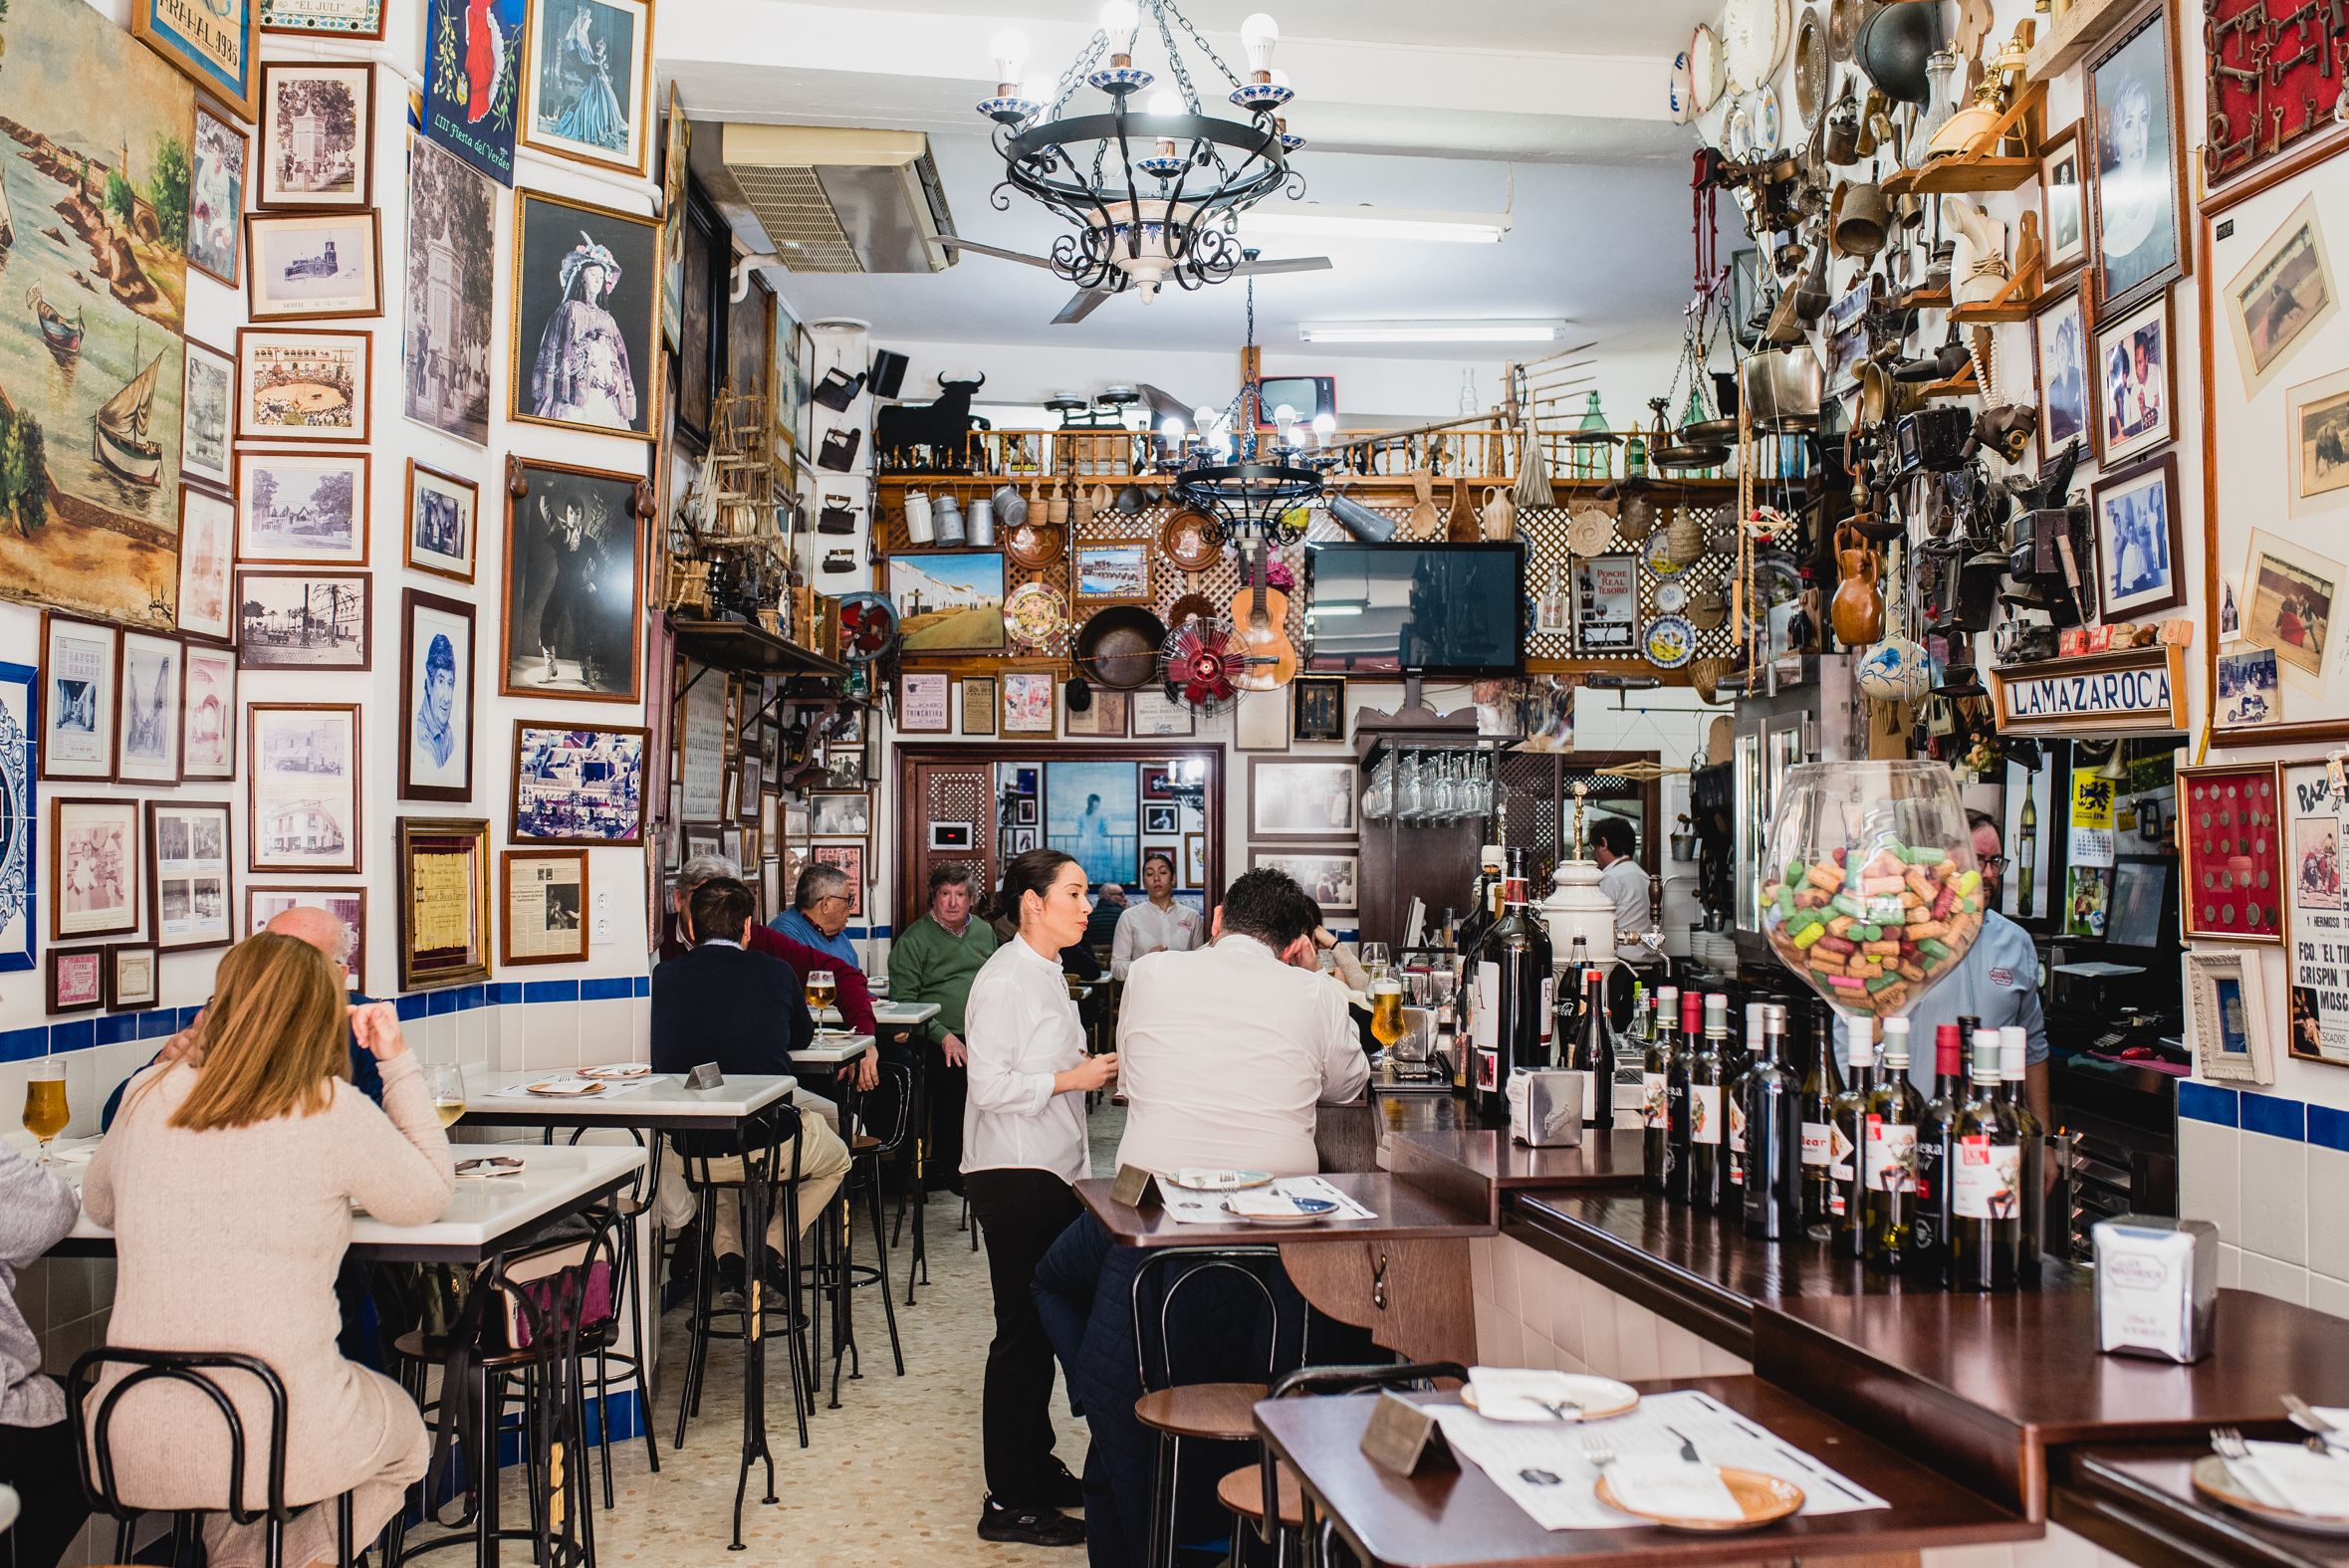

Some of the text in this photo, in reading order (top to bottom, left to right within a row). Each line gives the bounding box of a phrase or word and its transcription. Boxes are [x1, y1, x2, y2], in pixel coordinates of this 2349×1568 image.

[450, 123, 473, 147] Fiesta
[474, 138, 487, 156] del
[486, 144, 510, 171] Verdeo
[1597, 568, 1627, 578] PONCHE
[1601, 577, 1625, 586] REAL
[1597, 585, 1628, 595] TESORO
[2012, 671, 2171, 715] LAMAZAROCA
[2313, 916, 2340, 929] HERMOSO
[2298, 941, 2318, 962] FCO.
[2299, 966, 2338, 988] CRISPIN
